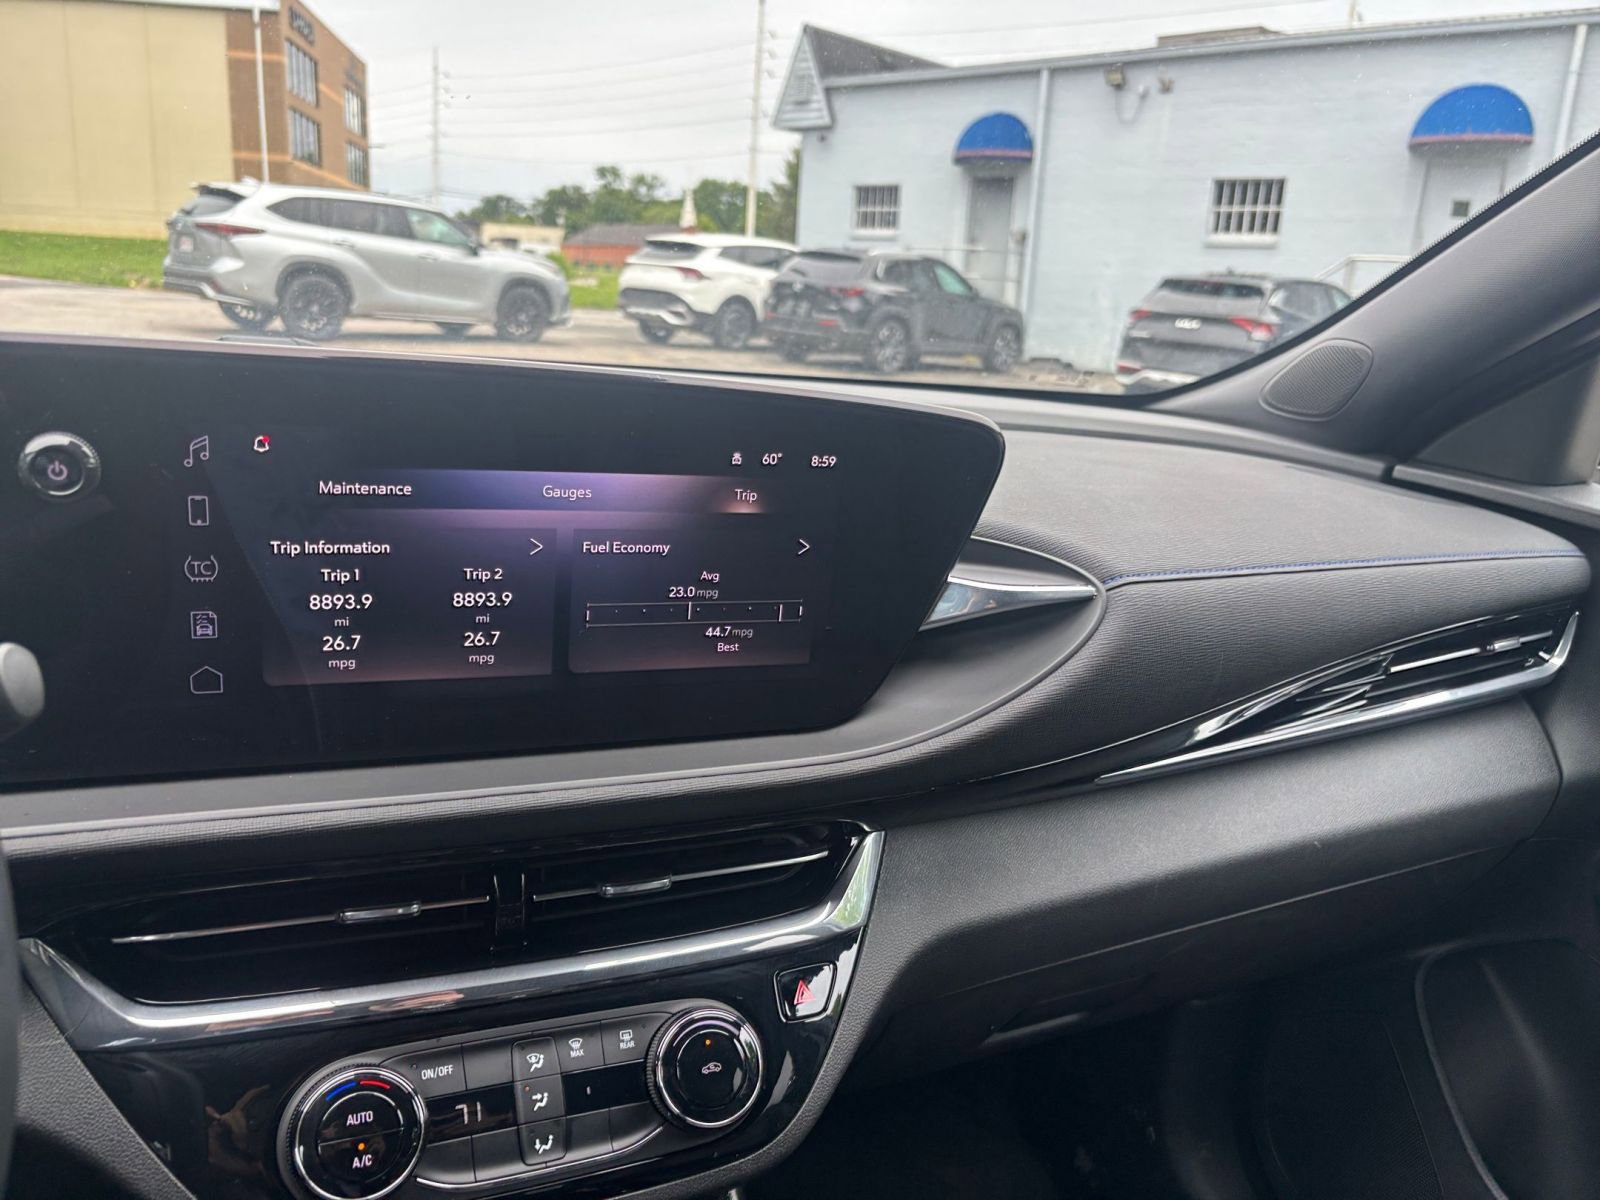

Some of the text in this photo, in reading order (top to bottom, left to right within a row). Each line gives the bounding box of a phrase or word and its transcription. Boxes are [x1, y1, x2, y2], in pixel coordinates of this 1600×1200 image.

[762, 453, 783, 465] 60°
[811, 455, 836, 468] 8:59
[318, 480, 412, 496] Maintenance
[542, 485, 592, 501] Gauges
[735, 489, 757, 504] Trip
[270, 540, 391, 557] Trip Information
[582, 541, 670, 557] Fuel Economy
[190, 561, 212, 575] TC
[463, 568, 503, 583] Trip 2
[321, 568, 360, 584] Trip 1
[700, 570, 720, 584] Avg
[452, 591, 512, 608] 8893.9
[669, 586, 719, 600] 23.0 mpg
[309, 593, 373, 610] 8893.9
[334, 616, 349, 627] mi
[475, 613, 490, 623] mi
[463, 631, 501, 647] 26.7
[705, 626, 731, 638] 44.7
[322, 635, 361, 651] 26.7
[717, 642, 740, 653] Best
[328, 658, 356, 670] mpg
[468, 653, 495, 665] mpg
[620, 1040, 635, 1050] REAR
[570, 1049, 584, 1058] MAX
[421, 1064, 454, 1080] ON/OFF
[346, 1110, 374, 1127] AUTO
[455, 1101, 482, 1125] 71
[352, 1154, 373, 1169] A/C
